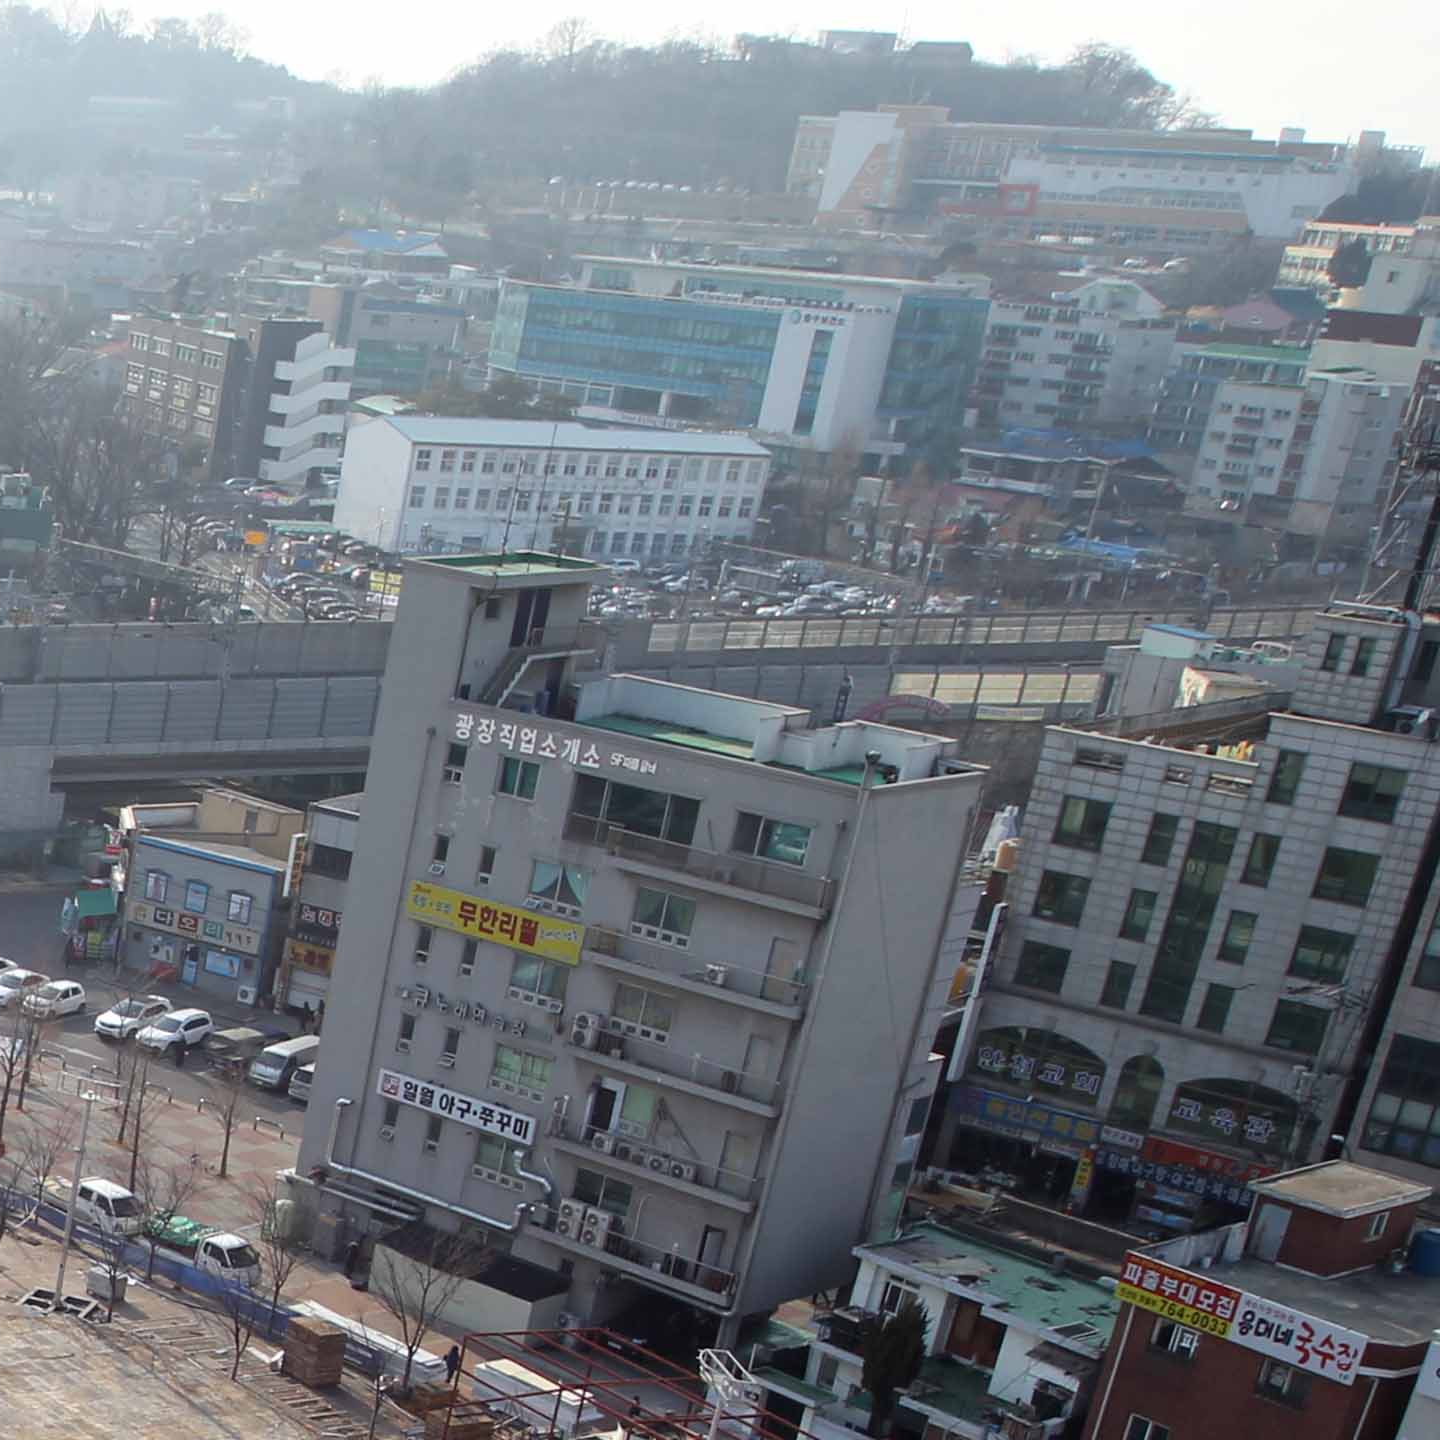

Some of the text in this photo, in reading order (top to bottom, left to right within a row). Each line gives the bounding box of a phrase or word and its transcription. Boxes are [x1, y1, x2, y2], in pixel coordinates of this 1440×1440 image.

[454, 712, 602, 769] 광장직업소개소
[458, 900, 540, 947] 무한리필
[1122, 1261, 1239, 1320] 파출부대모집
[1157, 1299, 1229, 1338] 764-0033
[1294, 1320, 1360, 1373] 국수집
